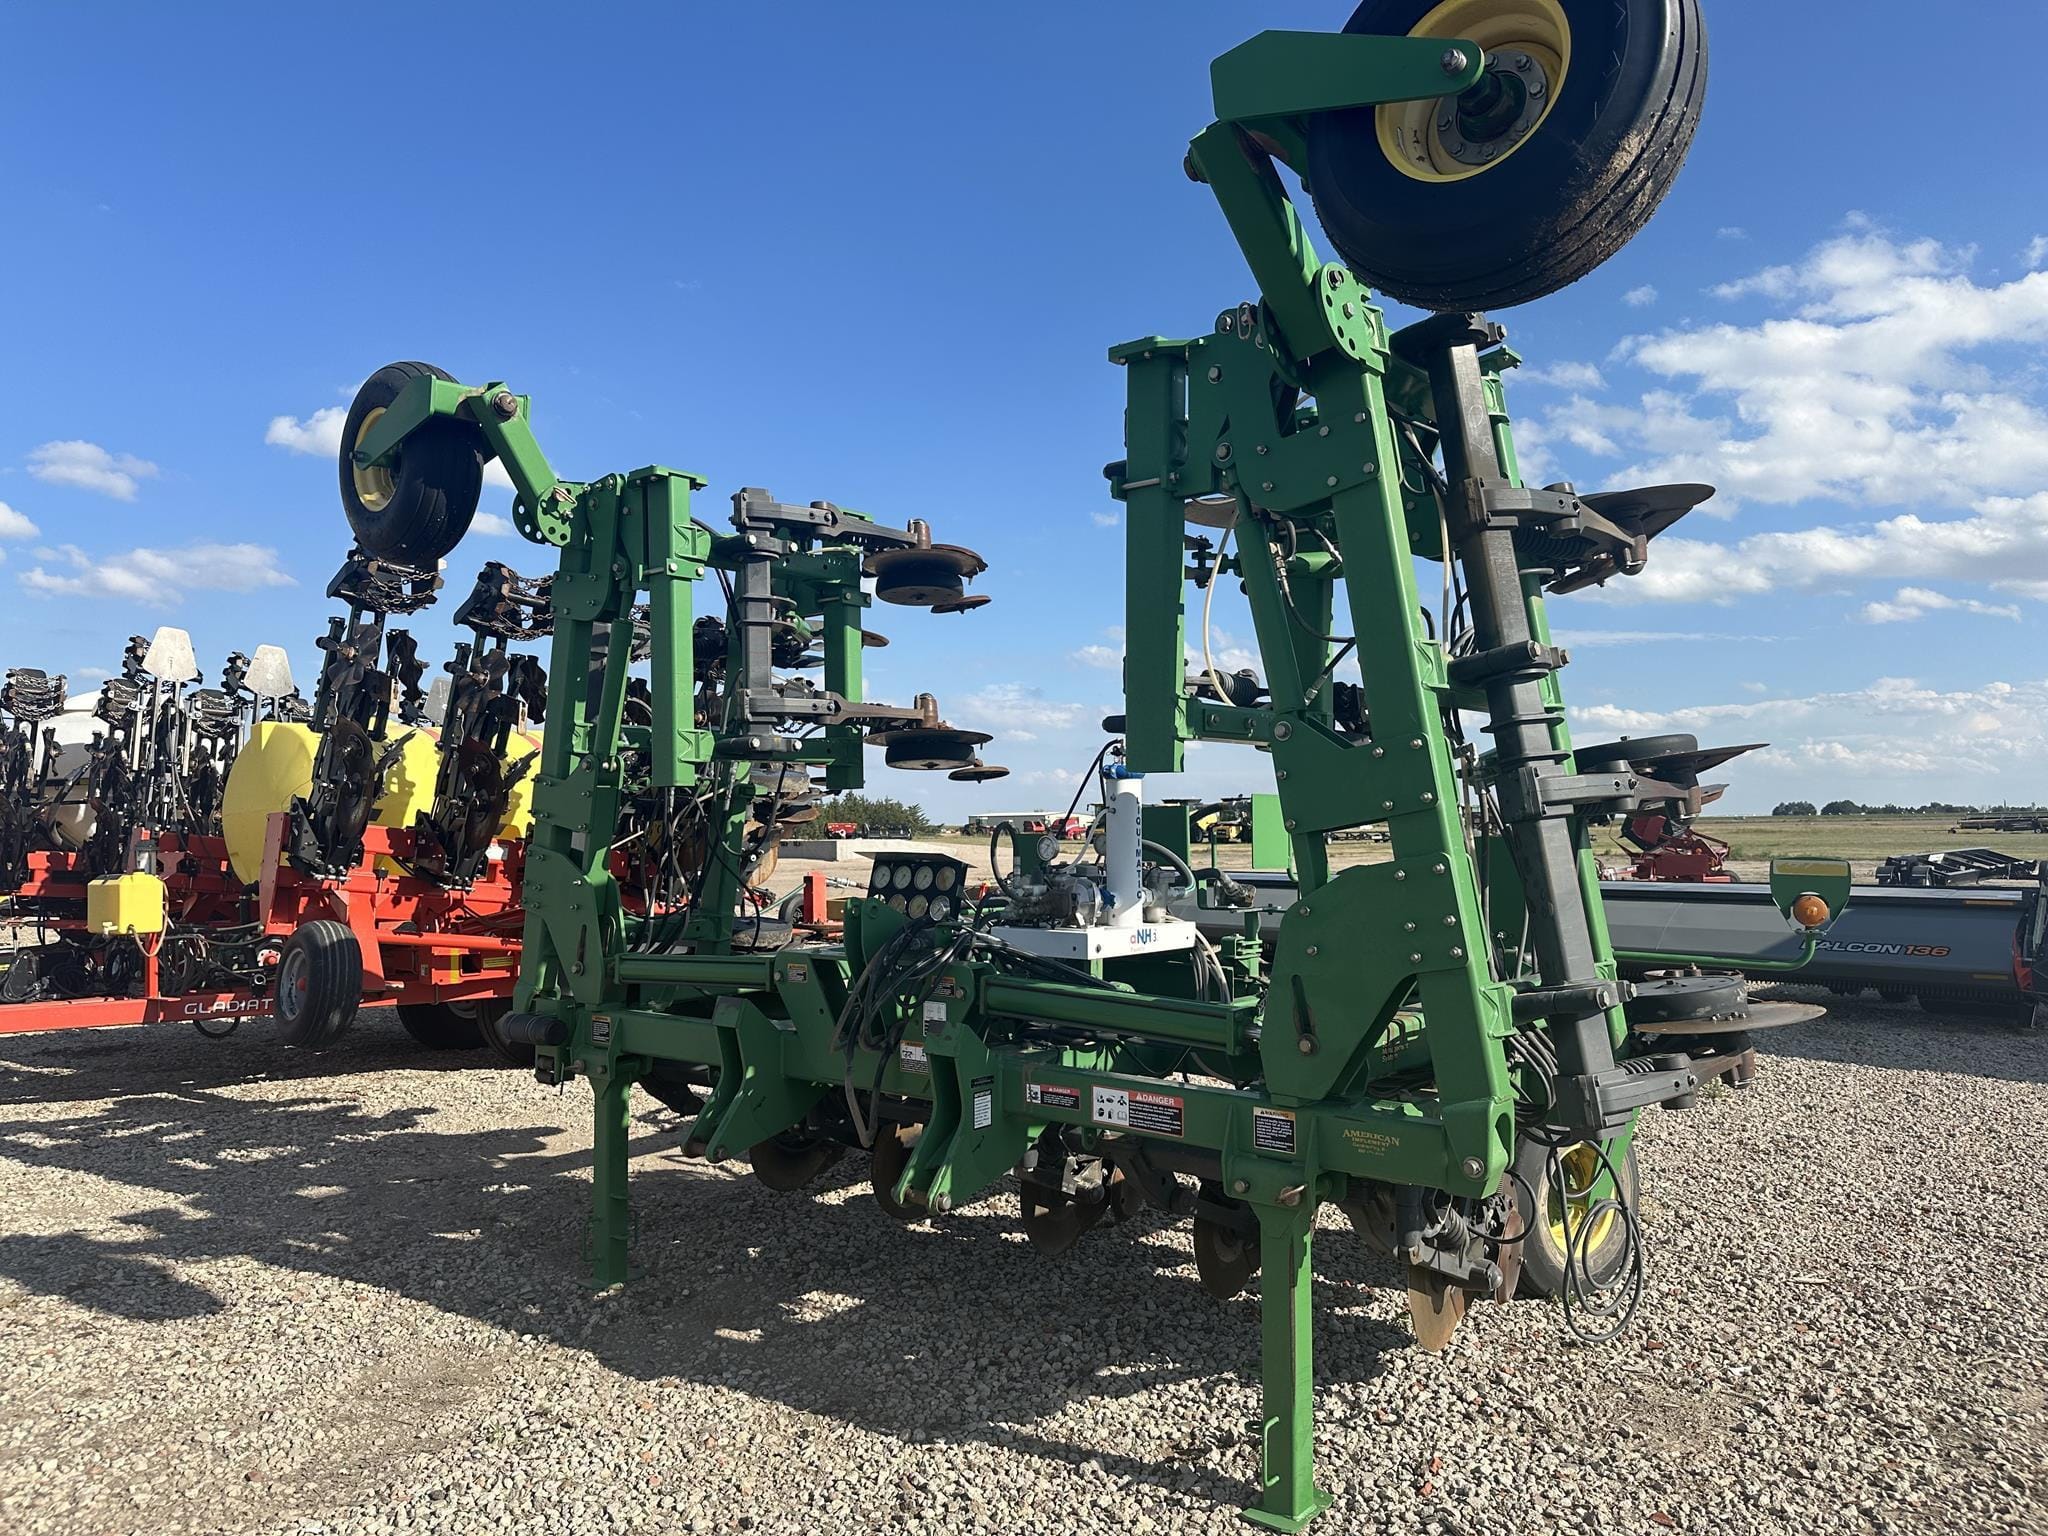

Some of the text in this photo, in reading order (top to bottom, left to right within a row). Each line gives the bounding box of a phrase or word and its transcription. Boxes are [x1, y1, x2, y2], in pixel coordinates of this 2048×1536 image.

[1135, 796, 1143, 899] LIQUIMATIC
[1904, 944, 1950, 957] 136
[1142, 1094, 1175, 1106] DANGER
[1343, 1129, 1400, 1147] AMERICAN
